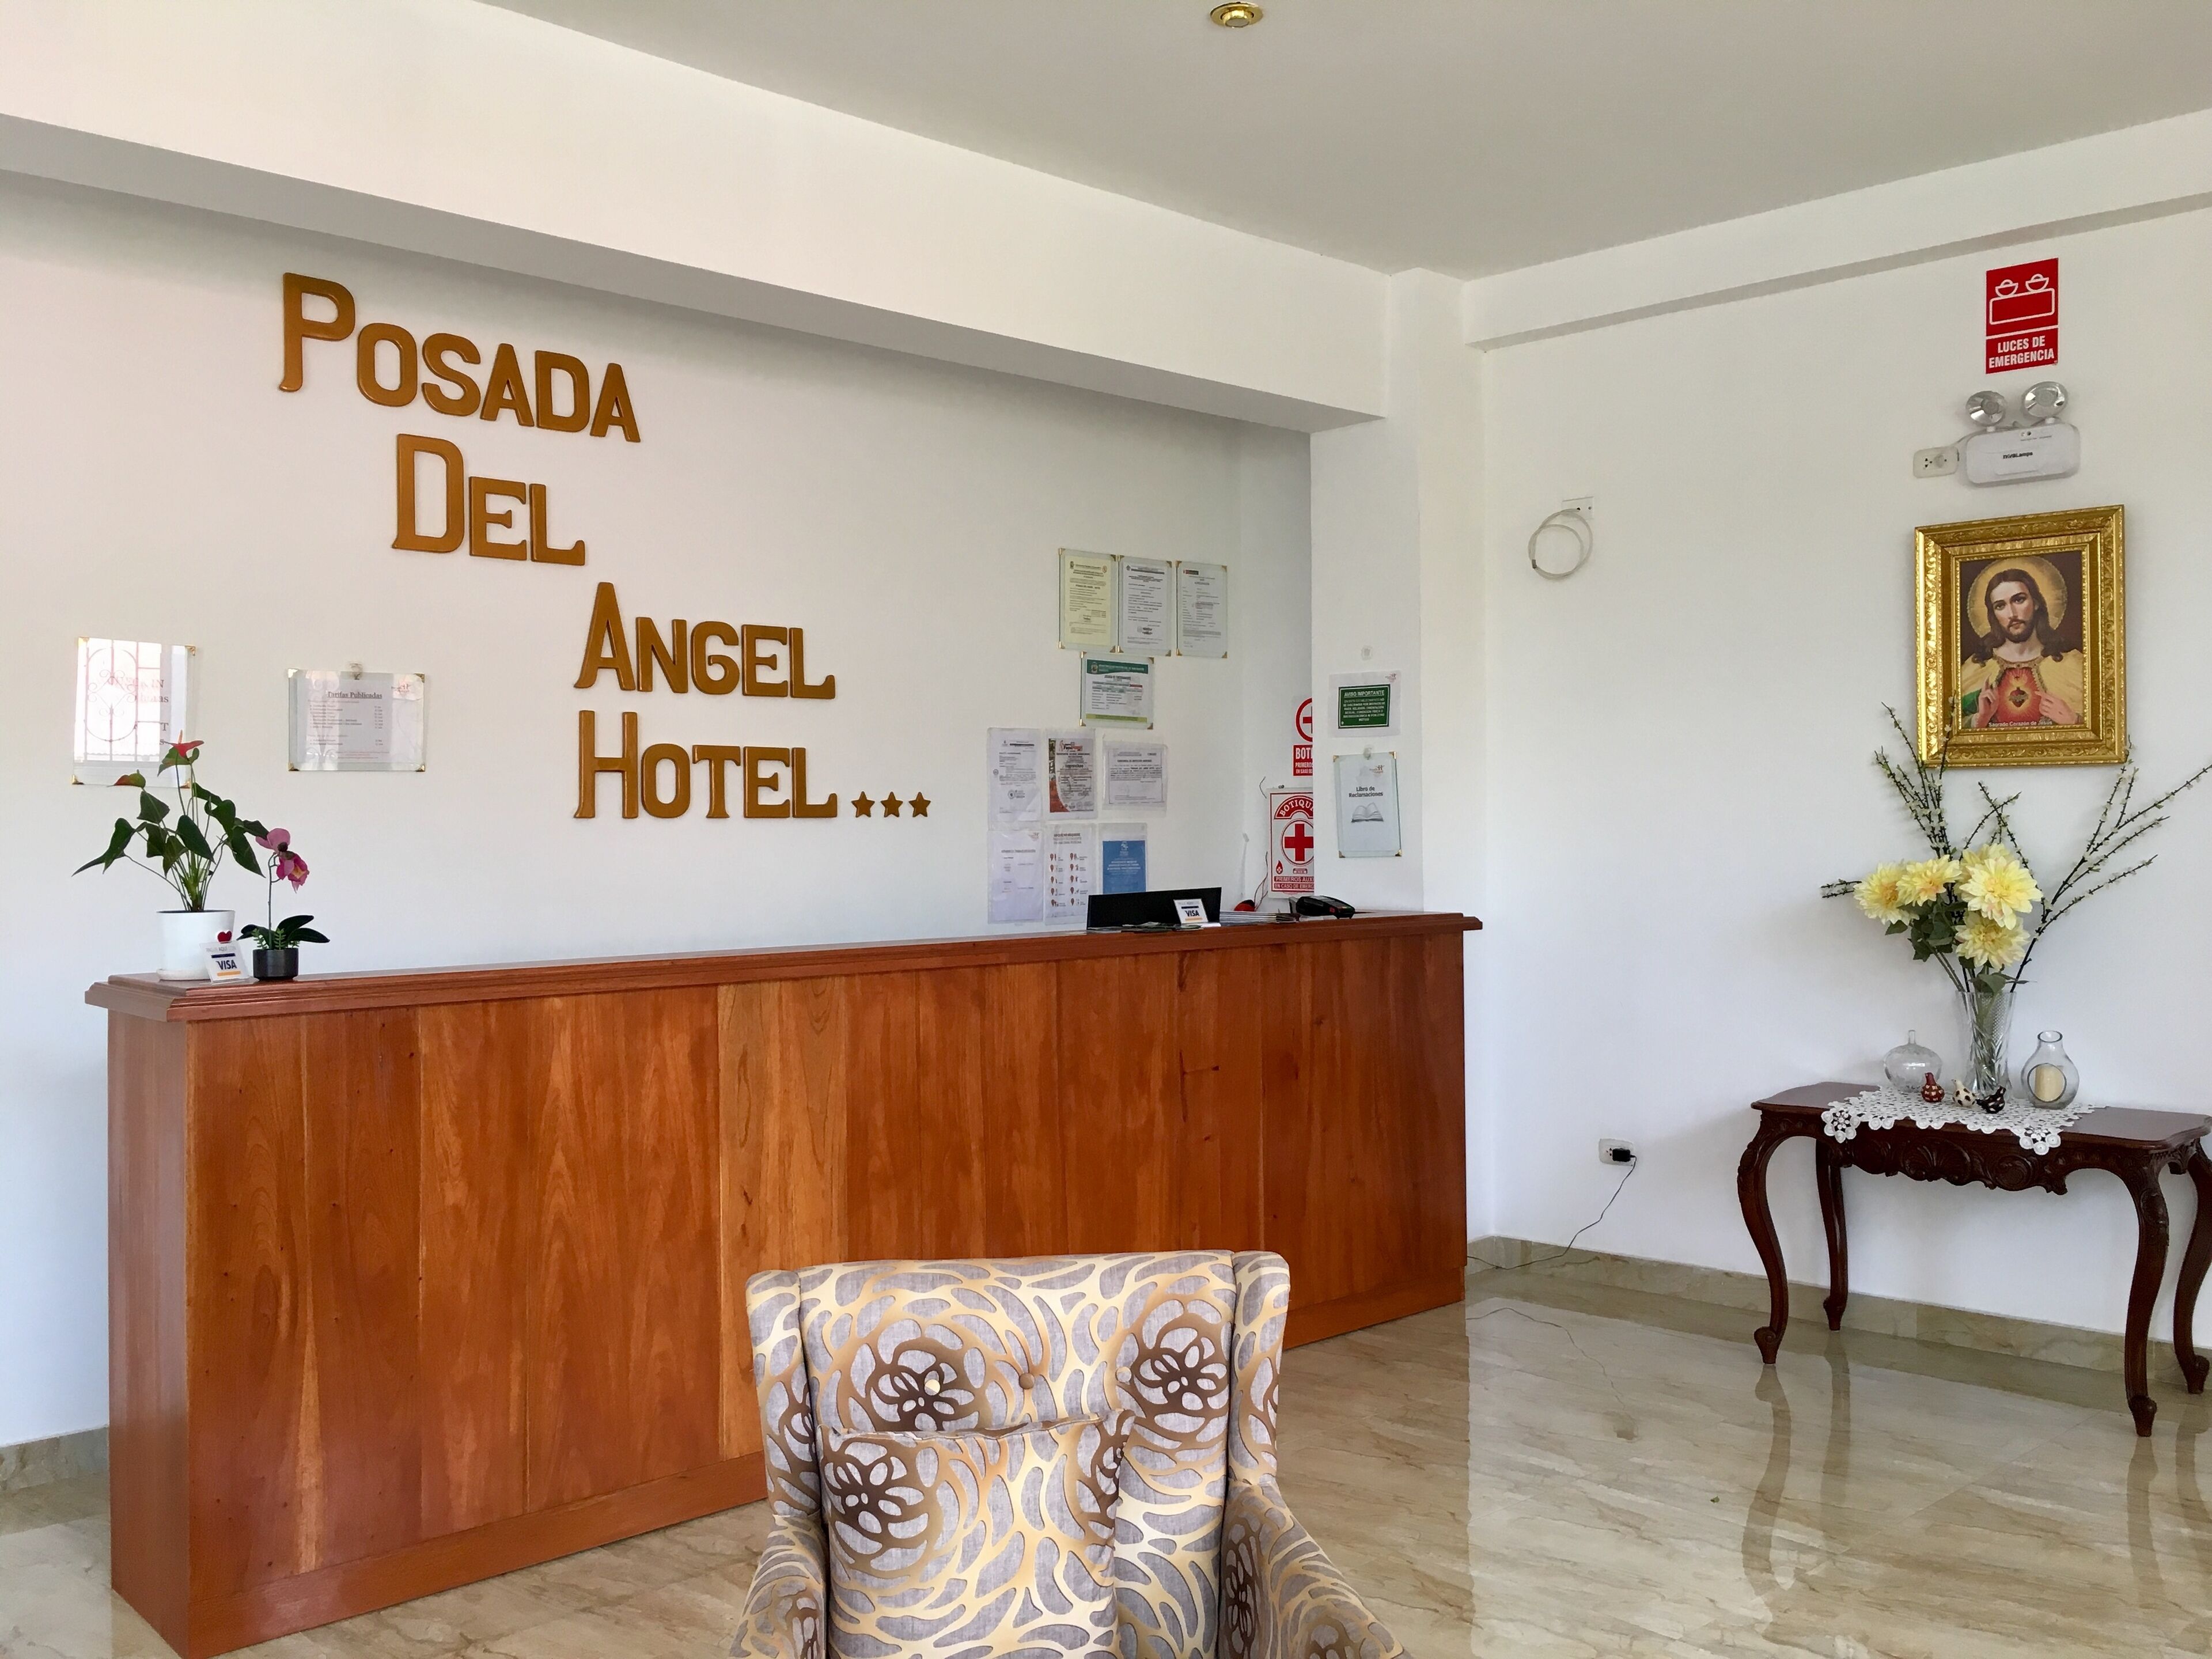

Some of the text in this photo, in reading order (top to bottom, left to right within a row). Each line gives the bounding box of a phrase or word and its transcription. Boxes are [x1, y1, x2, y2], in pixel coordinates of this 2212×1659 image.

[279, 272, 640, 442] POSADA
[1988, 348, 2055, 368] EMERGENCIA
[1997, 335, 2046, 353] LUCES DE
[391, 433, 585, 566] DEL
[573, 582, 836, 699] ANGEL
[350, 691, 382, 699] Publicadas
[573, 710, 838, 819] HOTEL
[215, 960, 237, 970] VISA
